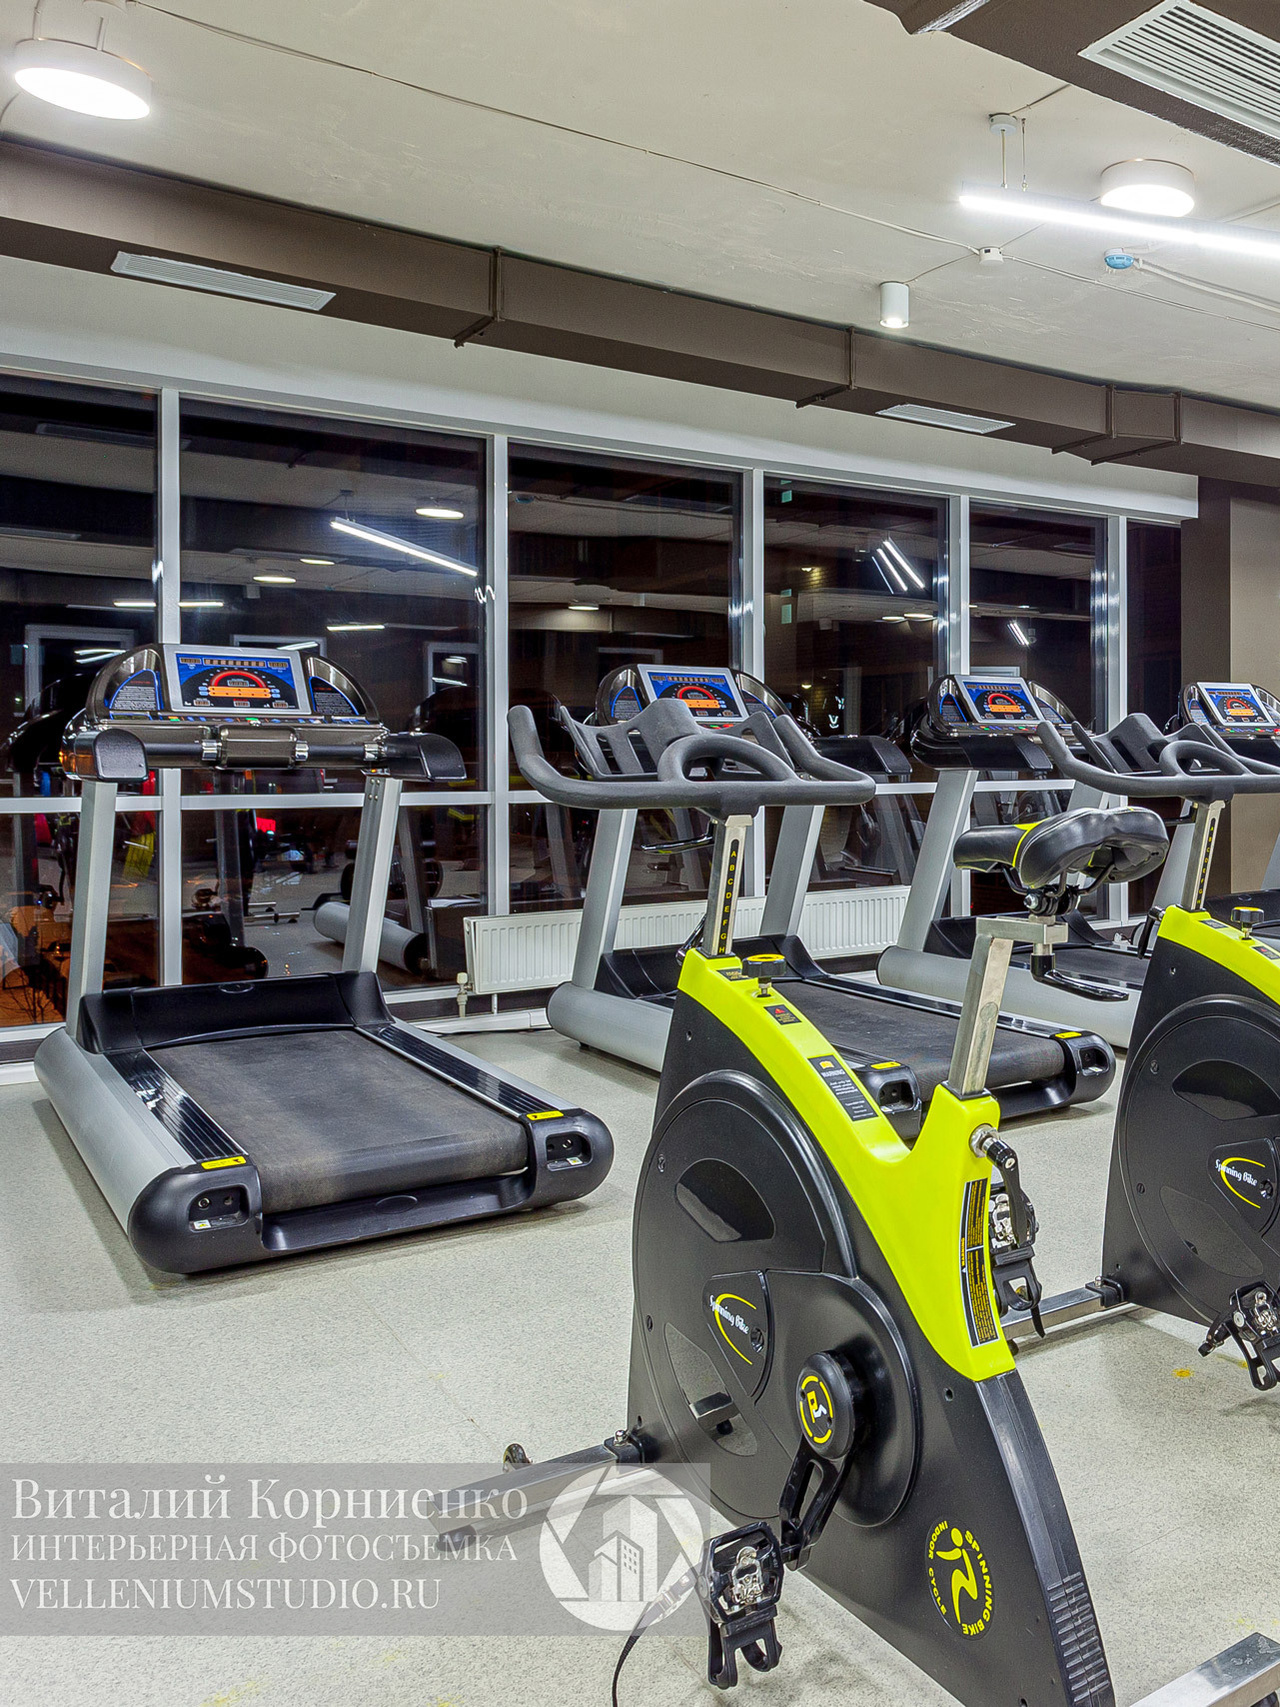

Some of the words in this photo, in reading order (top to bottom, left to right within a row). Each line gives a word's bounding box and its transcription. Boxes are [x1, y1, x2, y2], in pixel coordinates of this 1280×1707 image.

[1215, 1159, 1242, 1181] Spinning
[1242, 1171, 1257, 1186] Bike
[928, 1520, 949, 1560] INDOOR
[928, 1567, 947, 1615] CYCLE
[964, 1530, 992, 1622] SPINNING
[961, 1619, 985, 1636] BIKE
